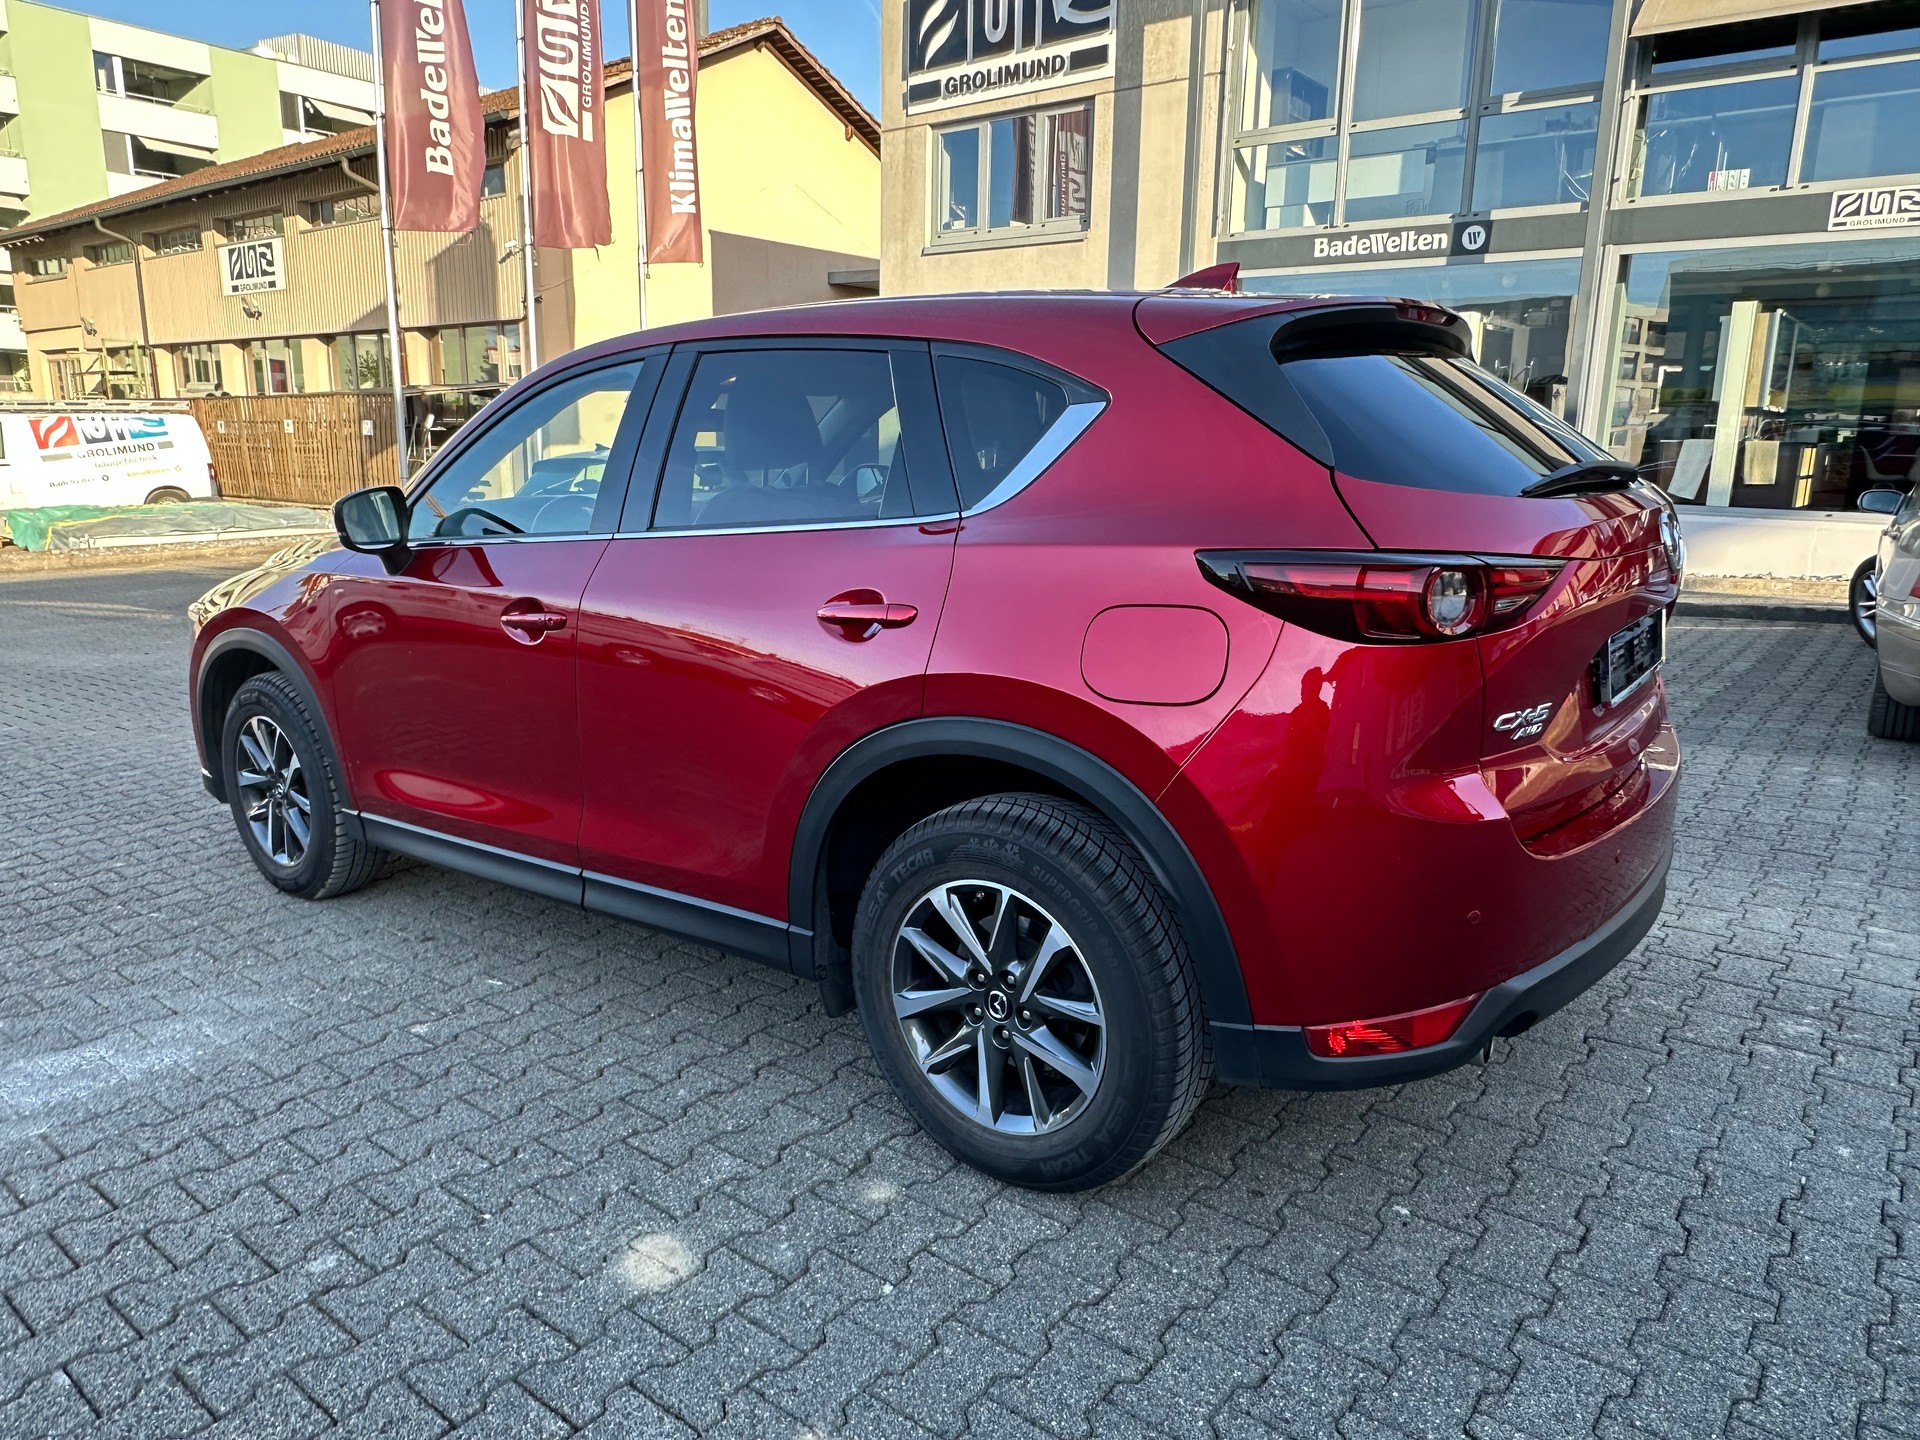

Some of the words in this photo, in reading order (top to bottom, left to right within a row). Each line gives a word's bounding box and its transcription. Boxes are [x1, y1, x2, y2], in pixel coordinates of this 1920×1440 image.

[580, 2, 592, 108] GROLIMUND
[944, 54, 1066, 96] GROLIMUND
[662, 0, 696, 214] KlimaWelten
[1849, 216, 1906, 227] GROLIMUND
[1313, 230, 1448, 258] BadeWelten
[76, 442, 155, 459] GROLIMUND
[1493, 702, 1553, 731] CX-5
[890, 847, 935, 883] TECAR
